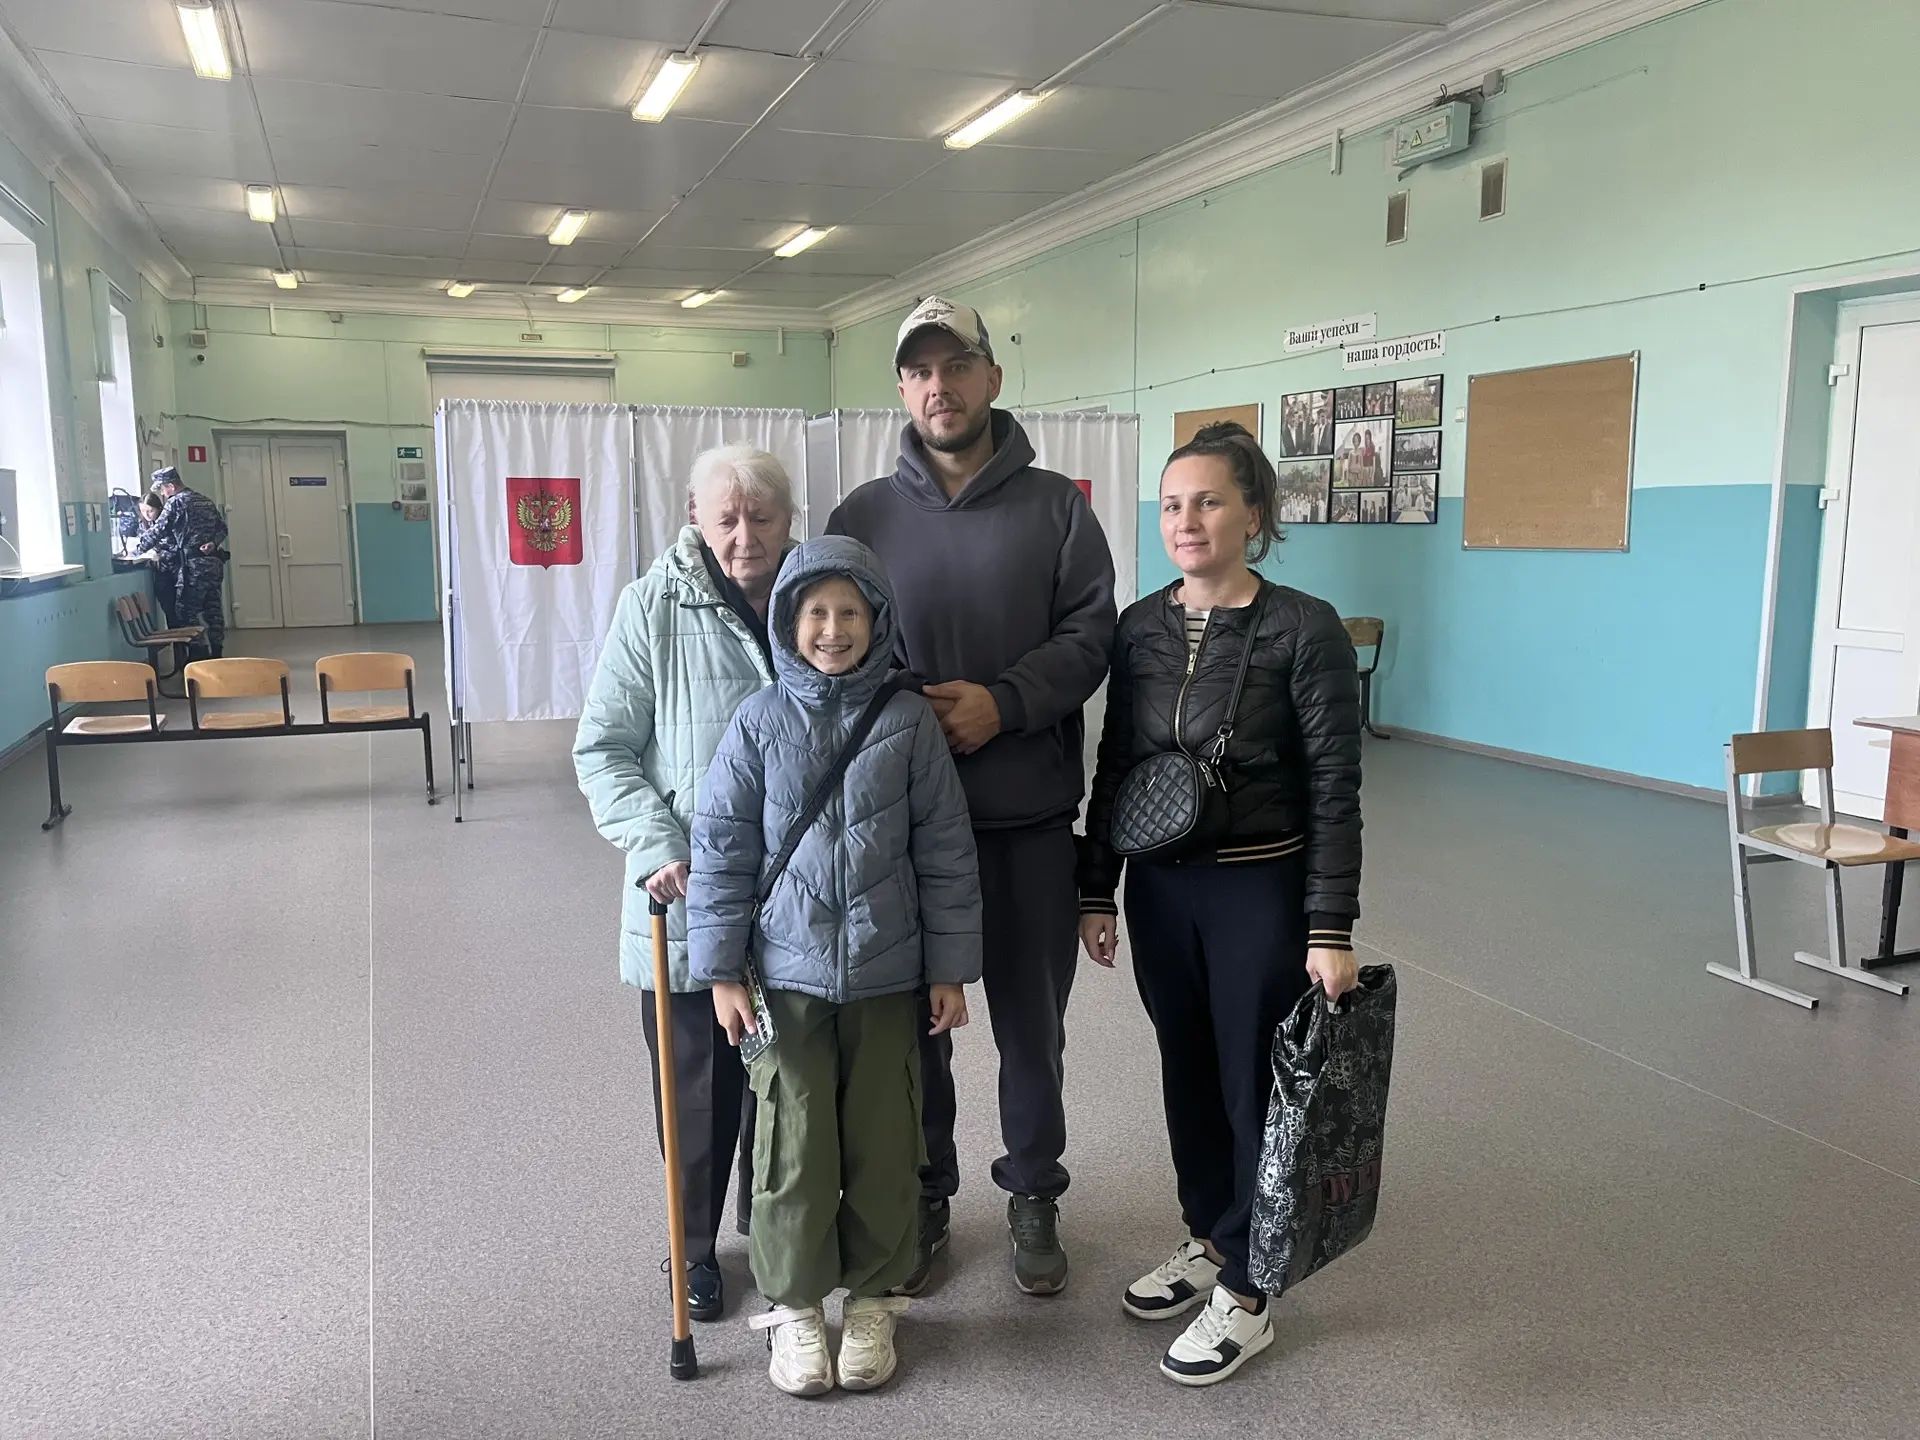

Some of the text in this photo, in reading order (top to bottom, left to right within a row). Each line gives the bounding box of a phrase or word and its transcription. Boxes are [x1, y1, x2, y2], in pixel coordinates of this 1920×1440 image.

[1289, 329, 1318, 345] Ваши
[1320, 321, 1359, 343] успехи
[1346, 333, 1441, 364] наша гордость!
